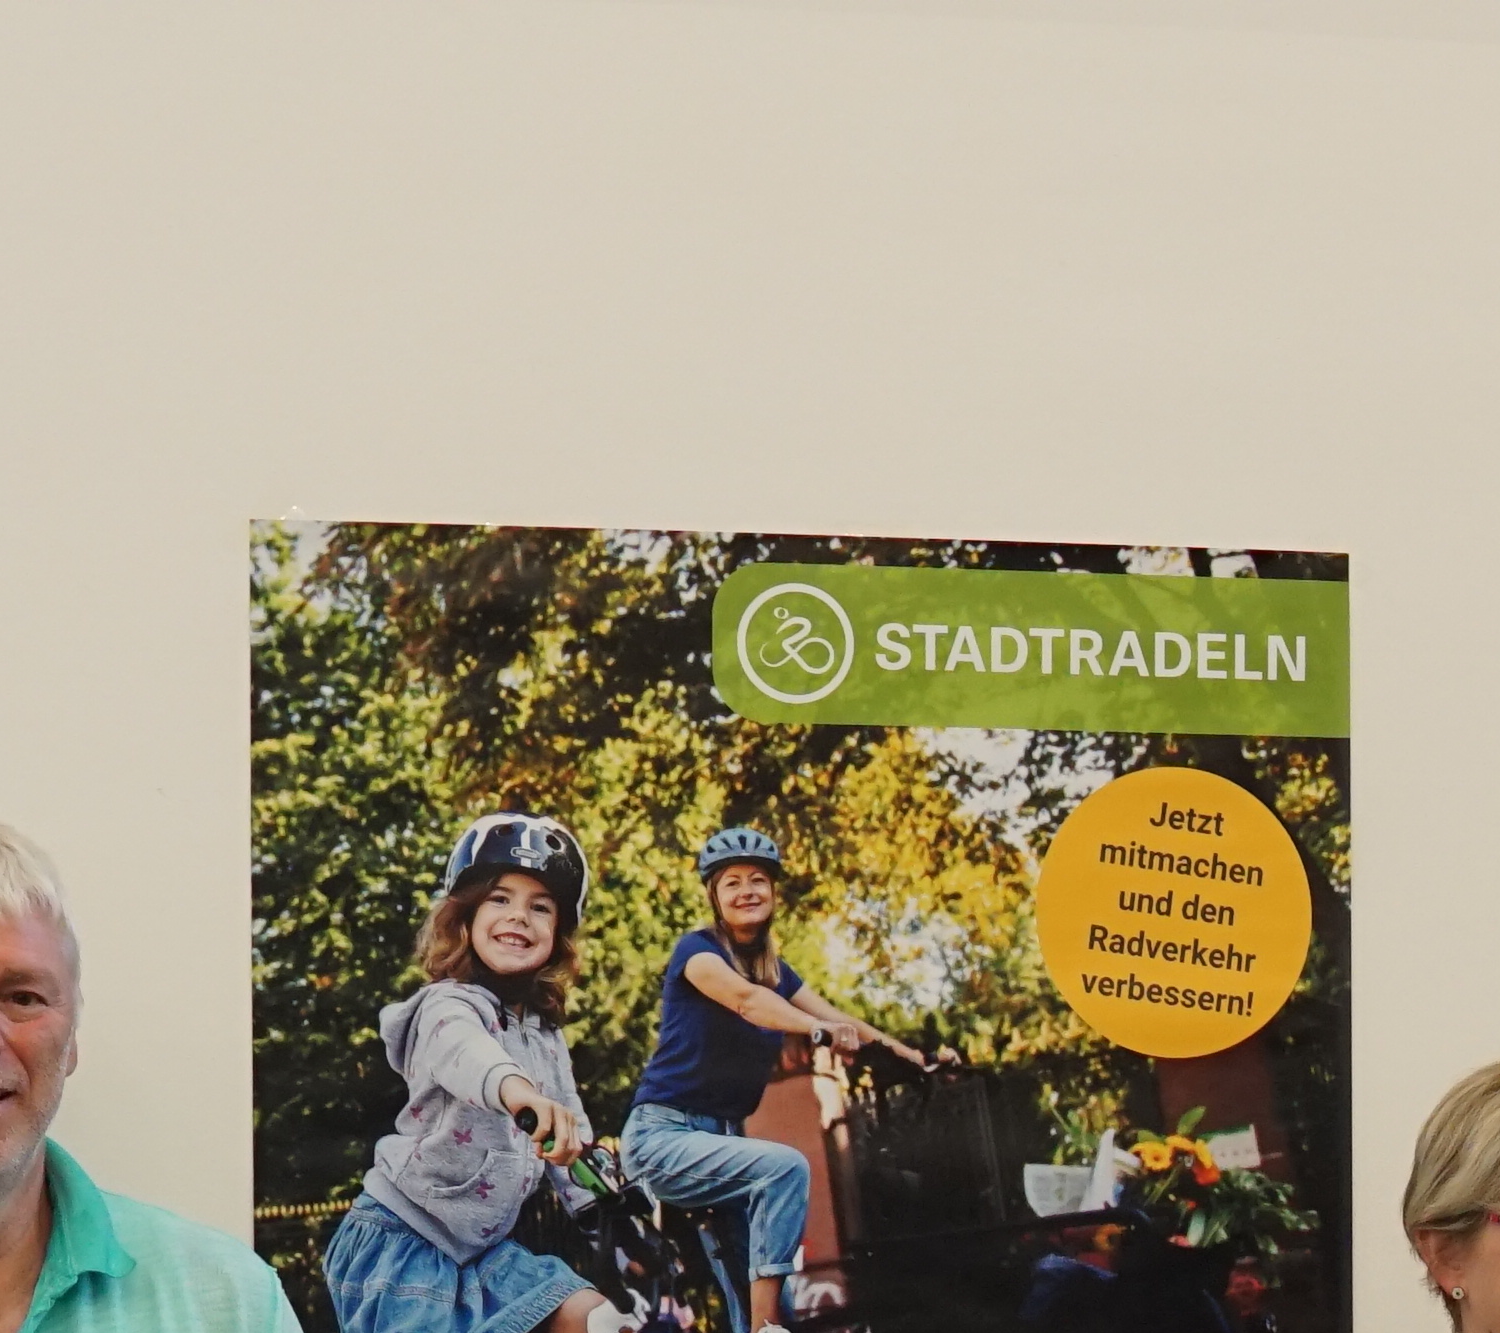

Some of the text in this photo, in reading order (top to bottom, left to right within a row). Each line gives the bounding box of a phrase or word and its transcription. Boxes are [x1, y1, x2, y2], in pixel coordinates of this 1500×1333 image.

[875, 622, 1307, 682] STADTRADELN
[1149, 799, 1225, 838] Jetzt
[1099, 838, 1265, 888] mitmachen
[1118, 888, 1236, 929] und den
[1087, 925, 1257, 975] Radverkehr
[1081, 971, 1255, 1018] verbessern!
